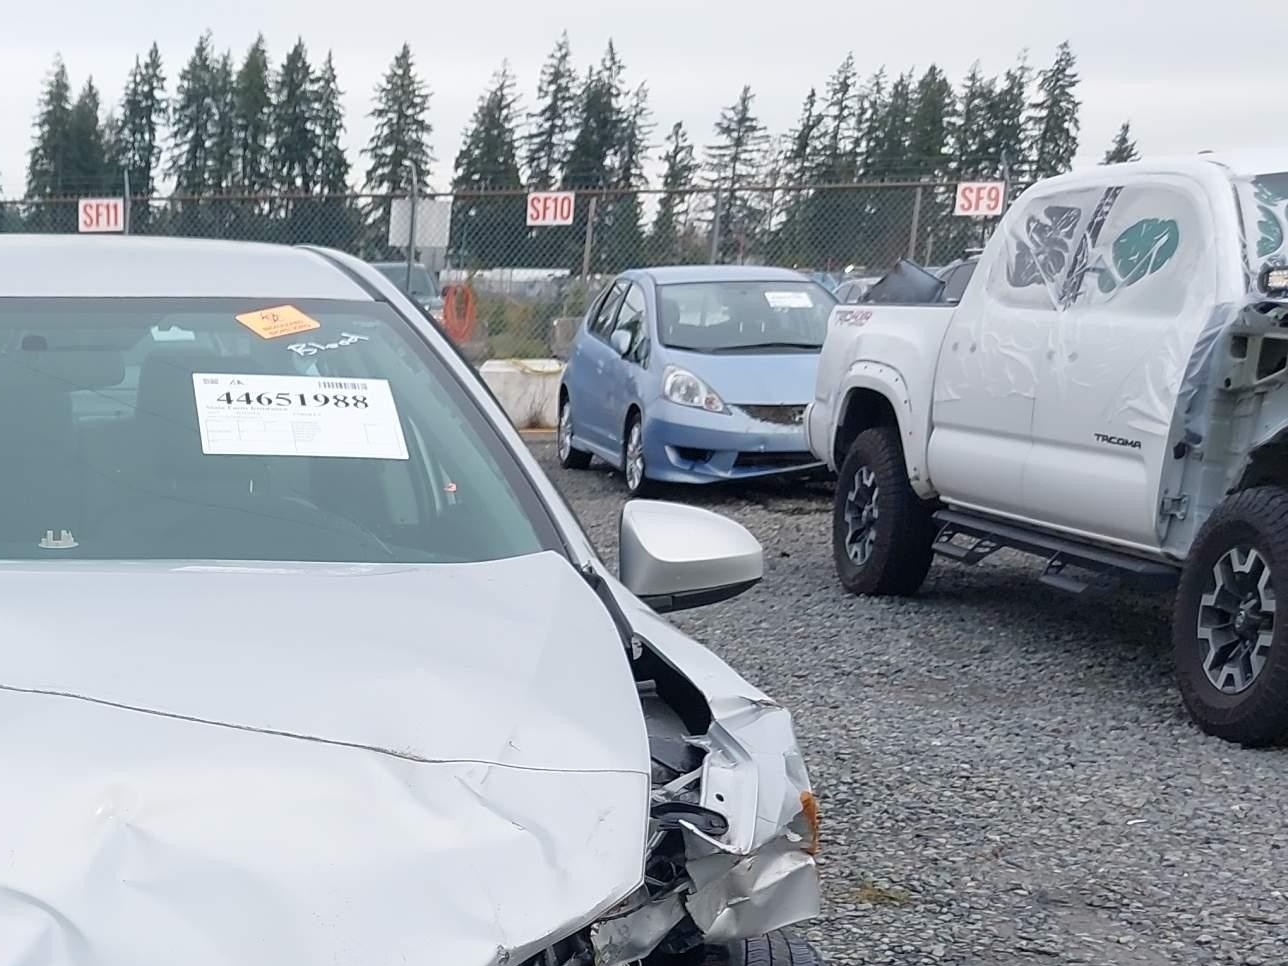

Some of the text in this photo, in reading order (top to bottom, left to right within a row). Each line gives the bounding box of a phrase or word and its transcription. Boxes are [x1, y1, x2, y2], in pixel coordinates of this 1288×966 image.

[530, 196, 572, 221] SF10
[960, 186, 1000, 212] SF9
[83, 203, 119, 228] SF11
[216, 391, 369, 409] 44651988
[1094, 432, 1142, 450] TACOMA
